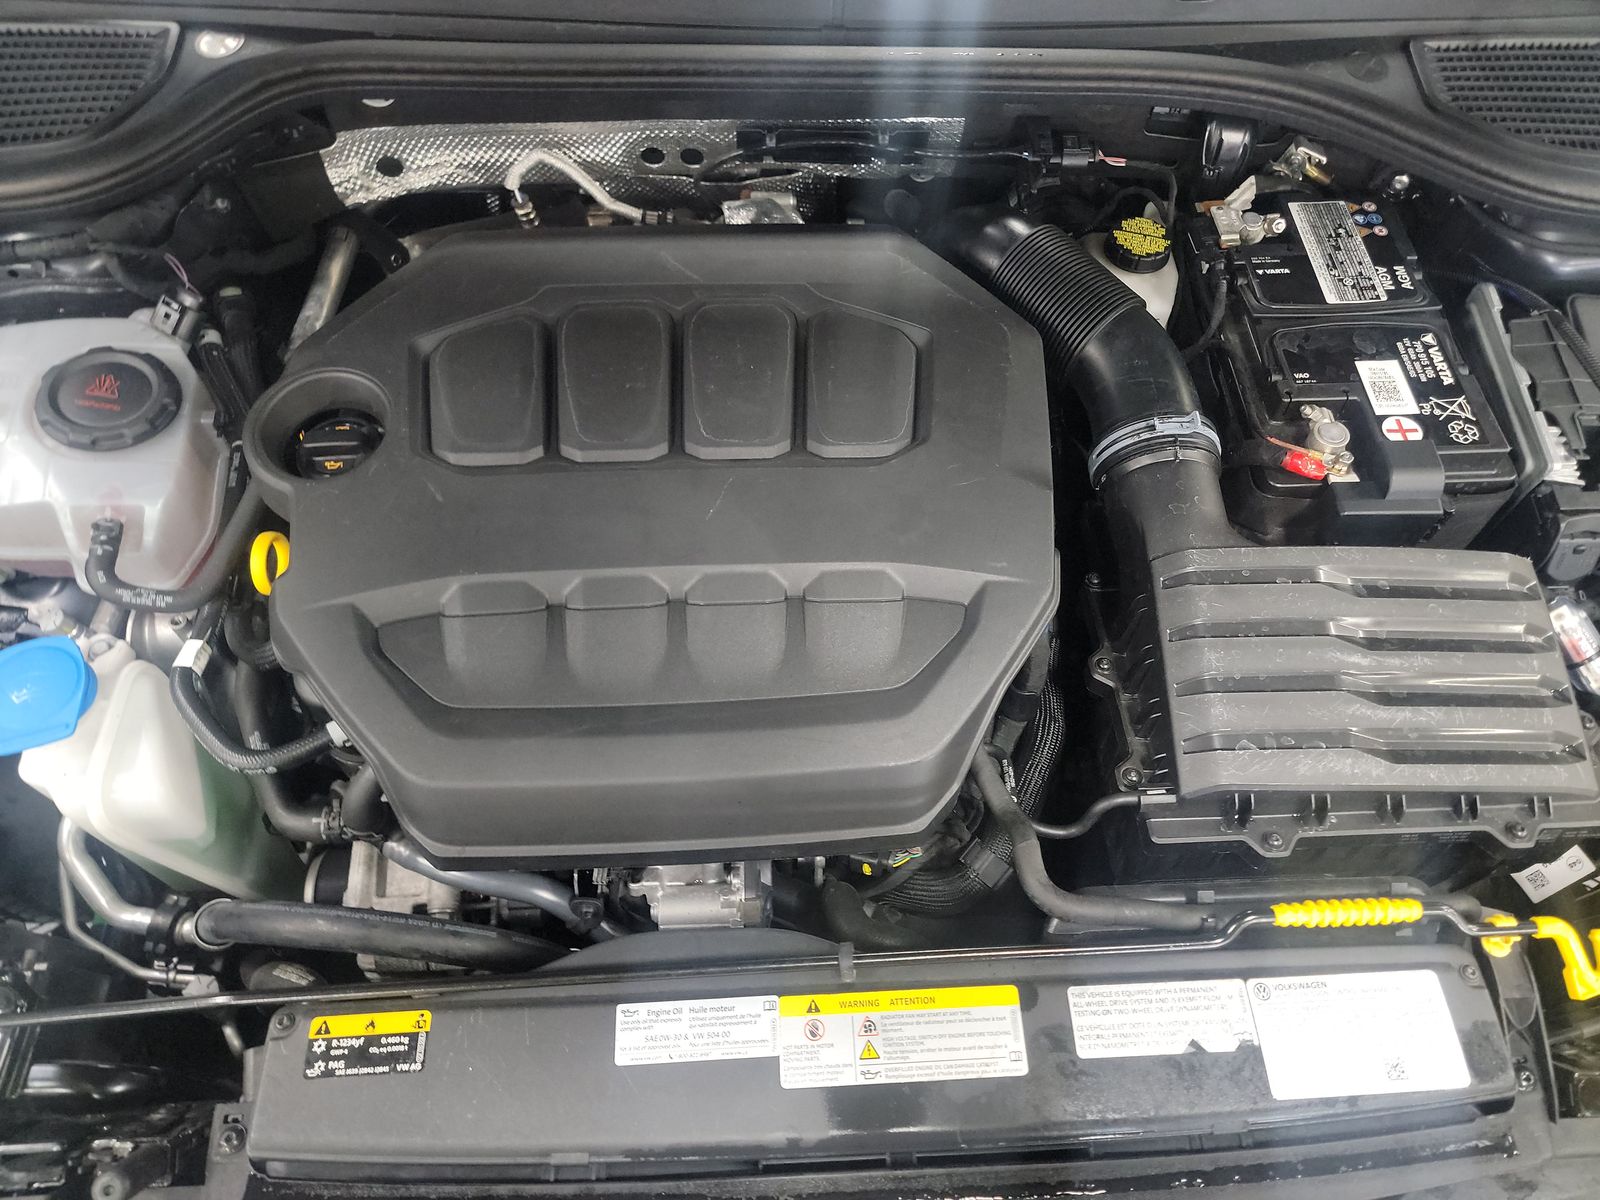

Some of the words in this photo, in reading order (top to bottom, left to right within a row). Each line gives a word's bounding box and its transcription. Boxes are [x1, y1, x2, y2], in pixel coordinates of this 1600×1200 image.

[1374, 266, 1395, 290] AGM
[1393, 266, 1414, 290] AGM
[1418, 353, 1430, 365] 915
[1428, 346, 1454, 386] VARTA
[1418, 403, 1432, 415] Pb
[1273, 981, 1327, 991] VOLKSWAGEN
[1121, 989, 1153, 997] EQUIPPED
[839, 999, 880, 1008] WARNING
[890, 996, 936, 1006] ATTENTION
[647, 1008, 671, 1017] Engine
[644, 1034, 658, 1042] SAE
[707, 1031, 720, 1039] 504
[332, 1037, 365, 1048] R-1234yf
[328, 1060, 345, 1069] PAG
[396, 1063, 410, 1071] VW
[410, 1063, 422, 1071] AG
